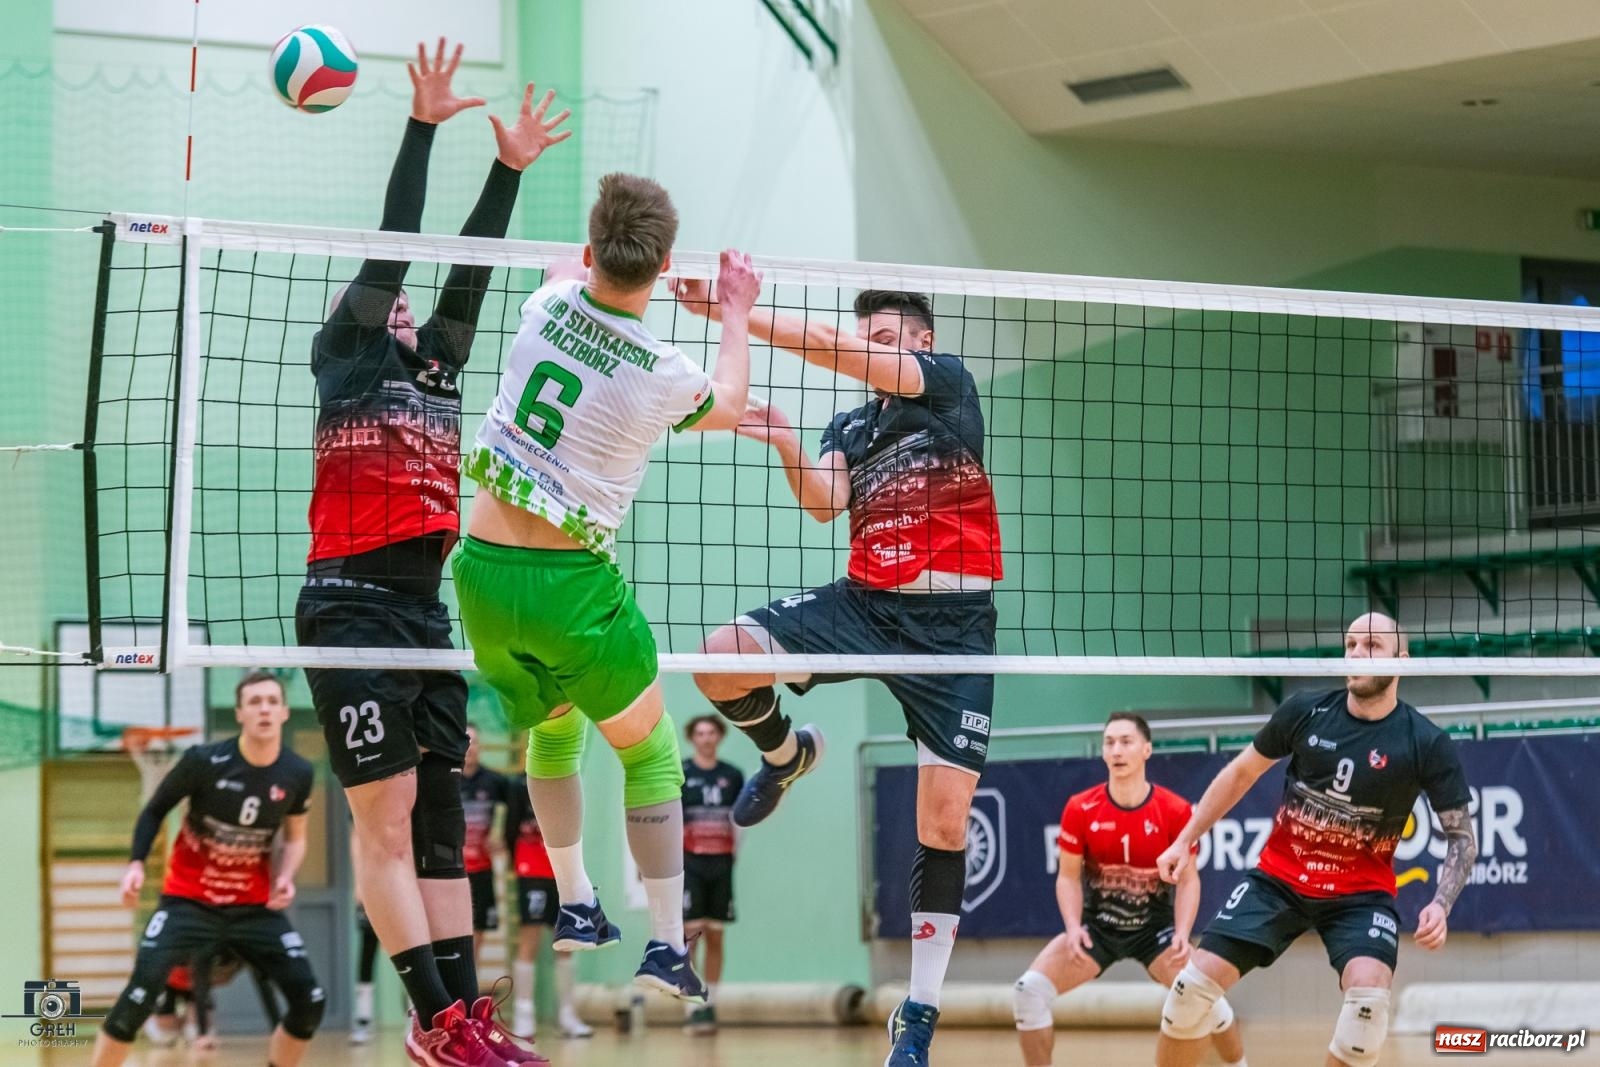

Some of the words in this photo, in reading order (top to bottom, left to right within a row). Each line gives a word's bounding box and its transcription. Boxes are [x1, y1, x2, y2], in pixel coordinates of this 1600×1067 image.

[129, 222, 168, 234] netex
[514, 360, 583, 450] 6
[115, 653, 154, 664] netex
[340, 700, 385, 750] 23
[1332, 758, 1355, 793] 9
[239, 796, 261, 826] 6
[1120, 833, 1130, 864] 1
[1225, 881, 1250, 910] 9
[145, 910, 169, 938] 6
